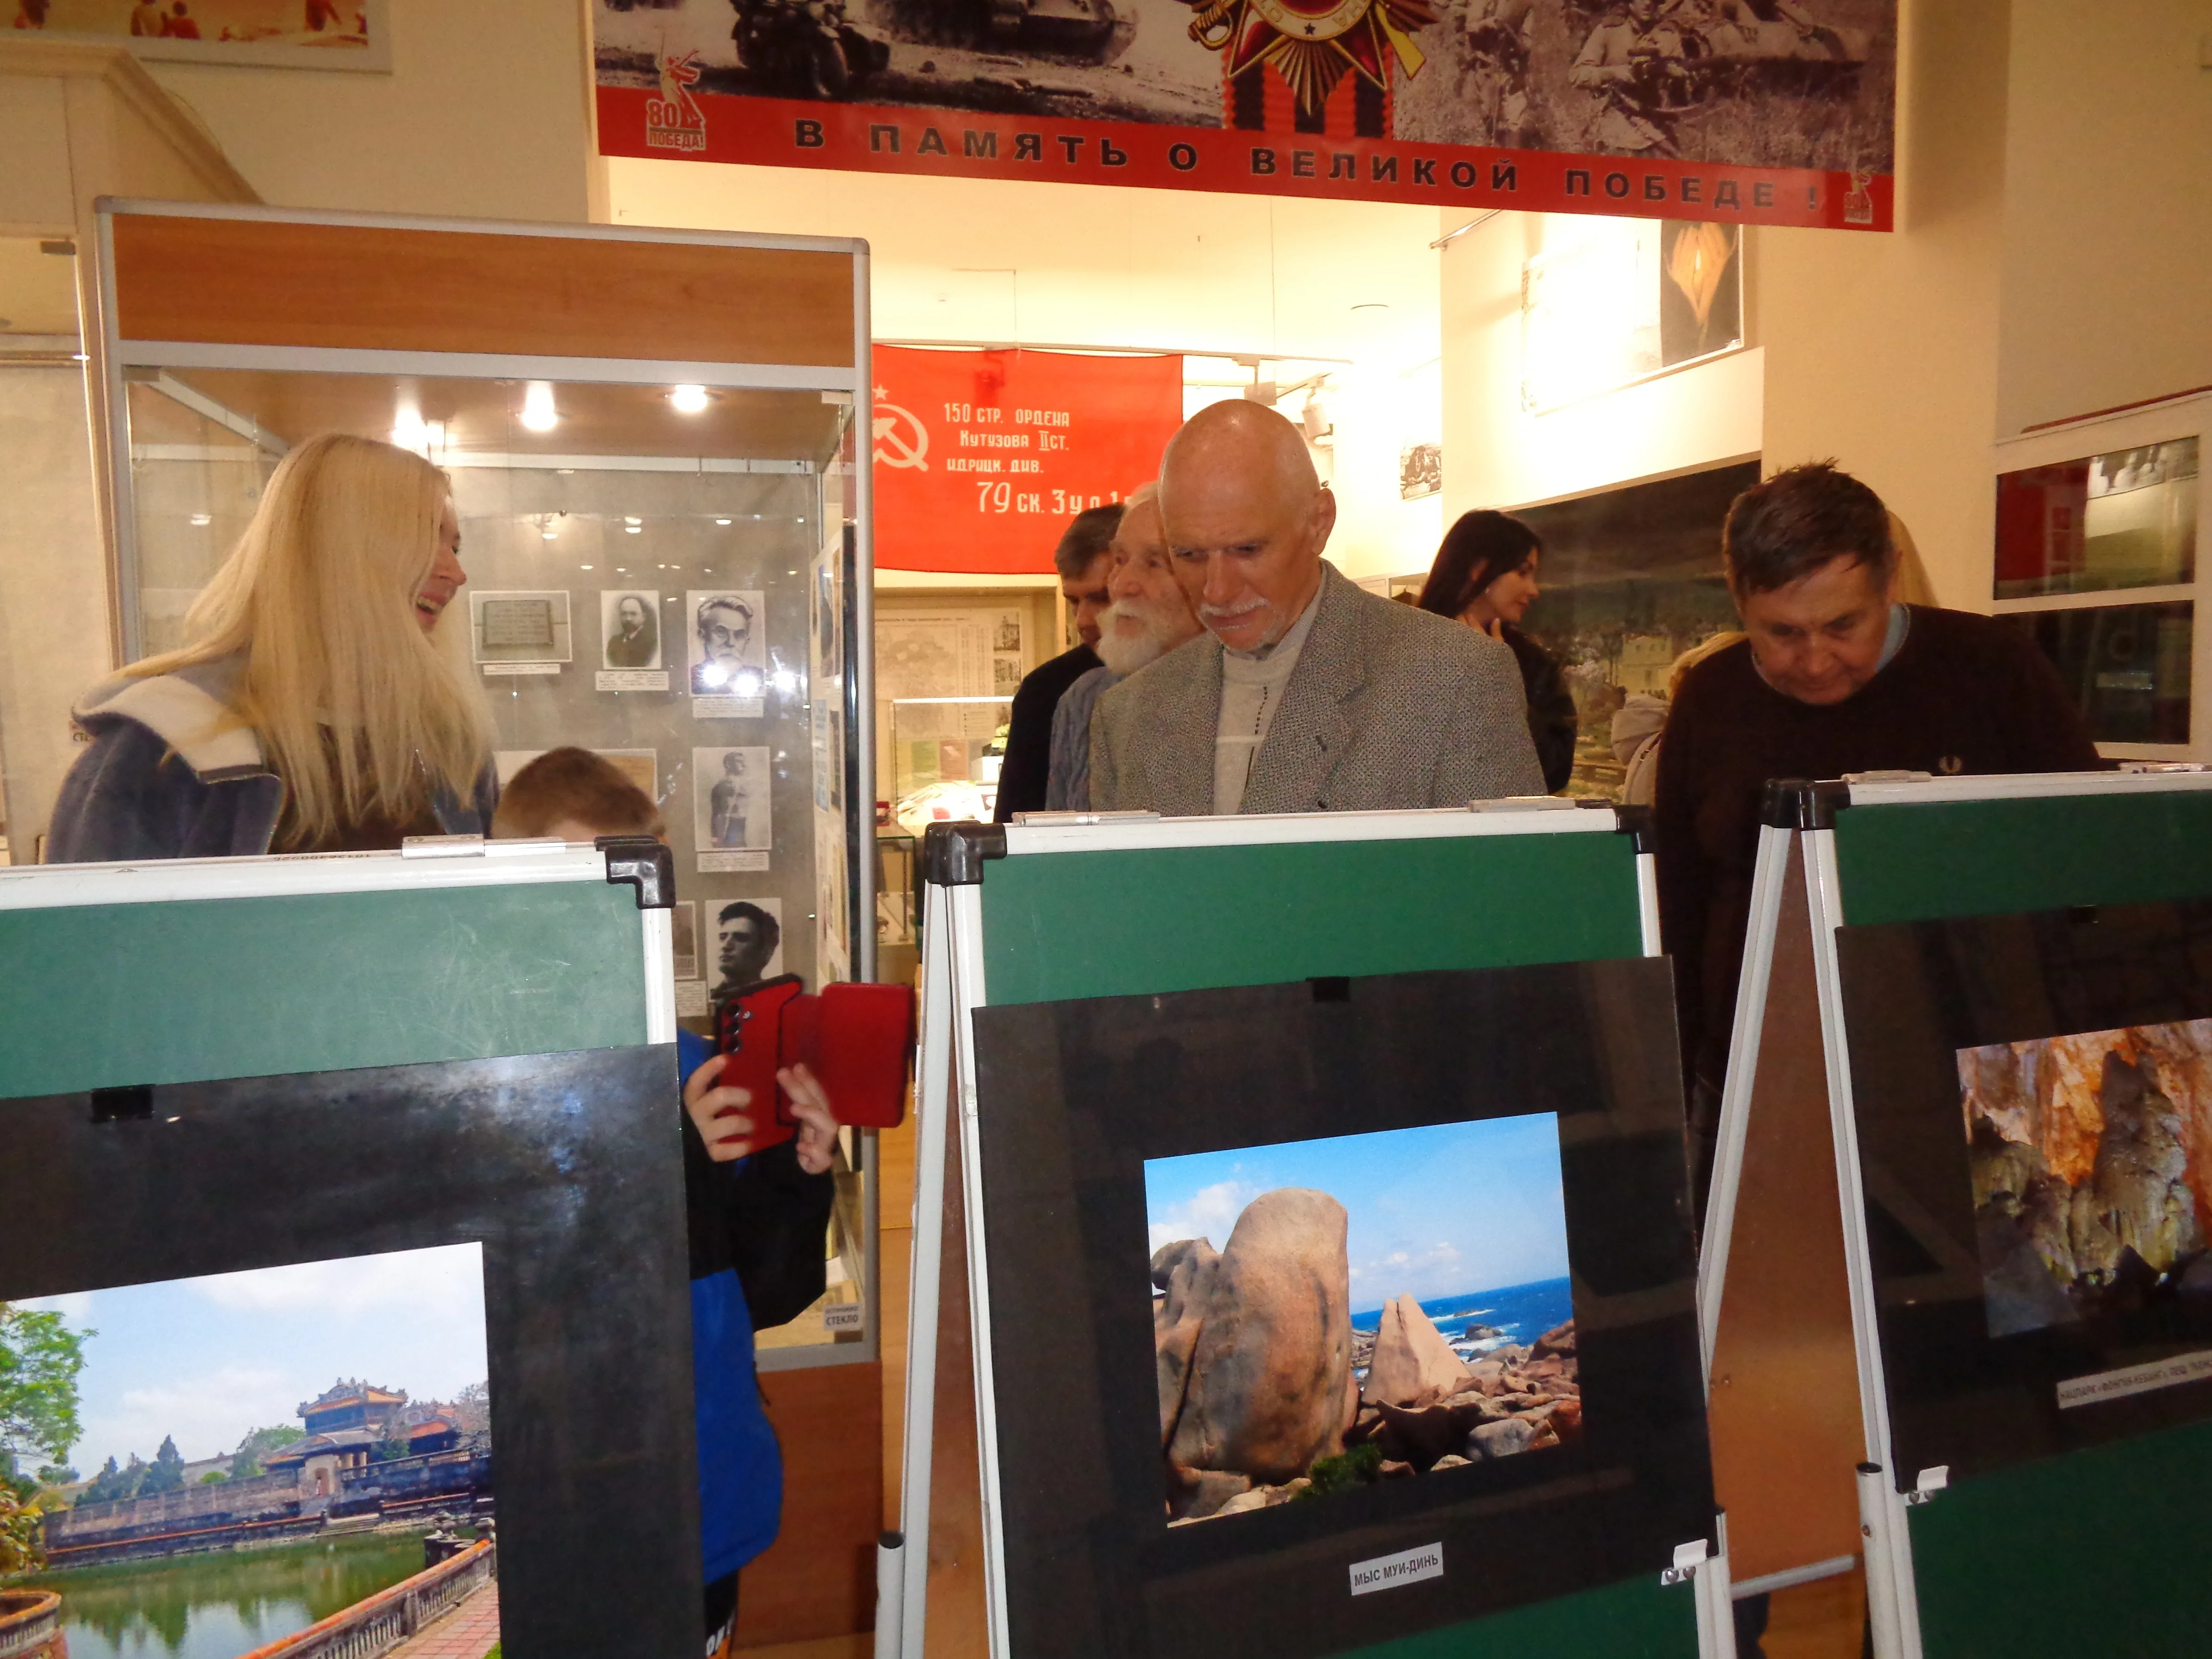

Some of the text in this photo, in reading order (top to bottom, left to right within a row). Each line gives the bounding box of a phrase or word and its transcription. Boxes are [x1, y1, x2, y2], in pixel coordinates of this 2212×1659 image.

[647, 101, 678, 128] 80
[795, 119, 825, 148] В
[869, 123, 1128, 167] ПАМЯТЬ
[1168, 143, 1198, 170] О
[1249, 146, 1518, 192] ВЕЛИКОЙ
[1565, 168, 1774, 210] ПОБЕДЕ
[944, 403, 1070, 427] 150 СТР. ОРДЕНА
[946, 458, 1045, 474] ИДРИЦК. ДИВ.
[977, 481, 1011, 513] 79
[1016, 492, 1045, 514] СК.
[826, 1315, 858, 1325] СТЕКЛО
[1354, 1554, 1438, 1586] МЫС МУИ-ДИНЬ
